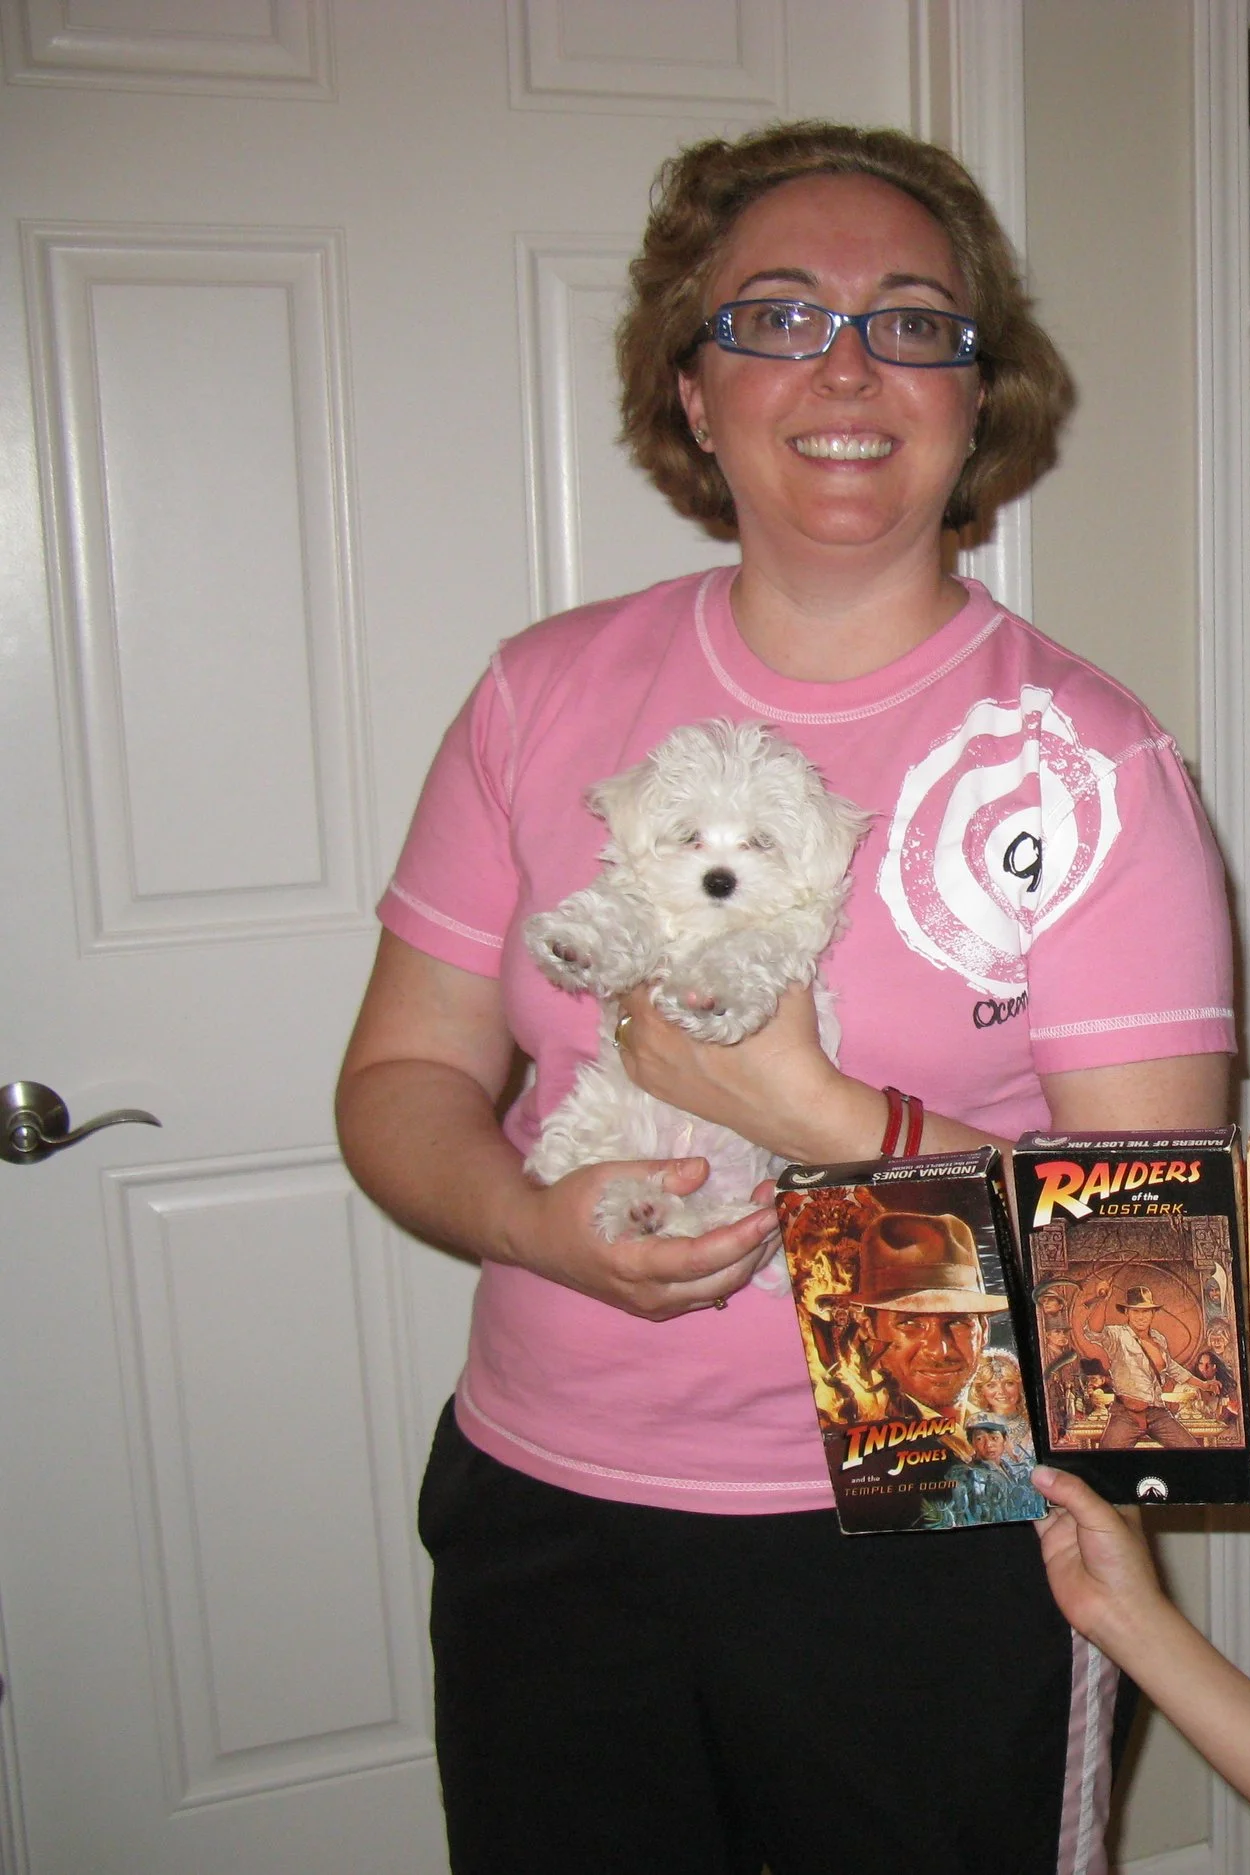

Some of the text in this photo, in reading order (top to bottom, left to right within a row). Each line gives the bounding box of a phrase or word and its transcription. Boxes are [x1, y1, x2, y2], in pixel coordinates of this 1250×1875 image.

[1172, 1139, 1224, 1147] RAIDERS
[872, 1165, 977, 1181] INDIANA JONES
[1032, 1160, 1202, 1229] RAIDERS
[1132, 1192, 1159, 1202] of the
[1100, 1203, 1184, 1215] LOST ARK
[842, 1416, 958, 1471] INDIANA
[888, 1450, 948, 1476] JONES
[844, 1480, 958, 1496] TEMPLE OF DOOM
[851, 1476, 866, 1484] and
